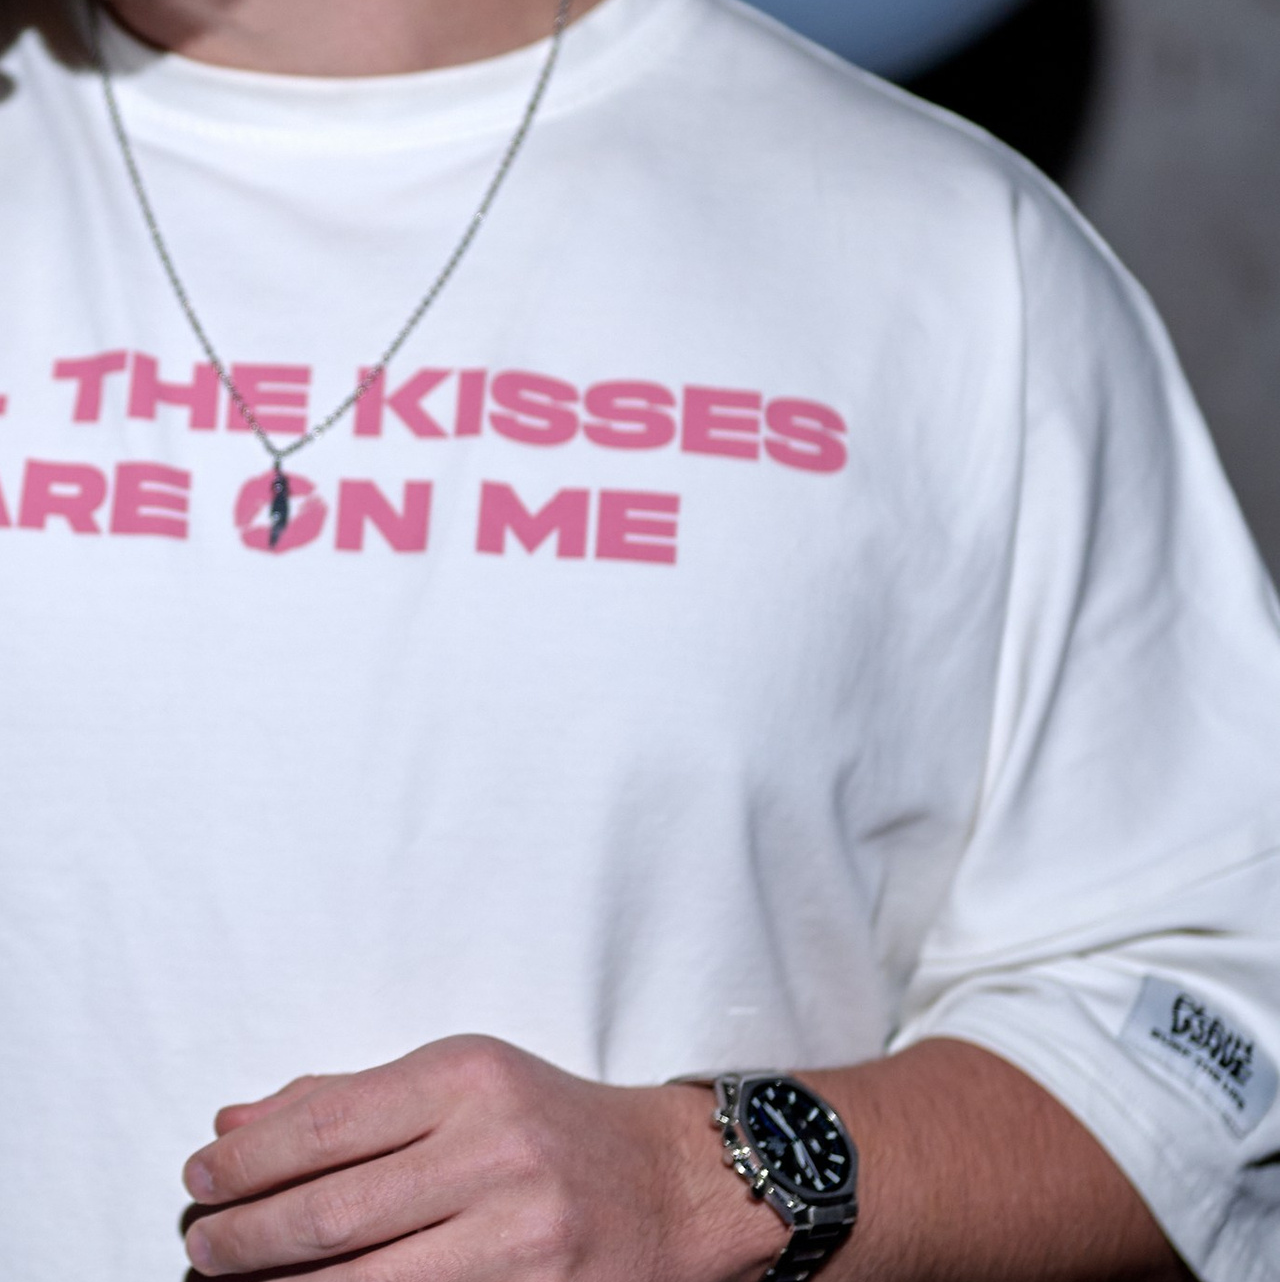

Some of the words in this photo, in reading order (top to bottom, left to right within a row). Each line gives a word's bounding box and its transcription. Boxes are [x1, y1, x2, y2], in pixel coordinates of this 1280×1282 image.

[53, 350, 311, 436] THE
[353, 367, 848, 475] KISSES
[234, 468, 432, 554] ON
[476, 481, 680, 565] ME
